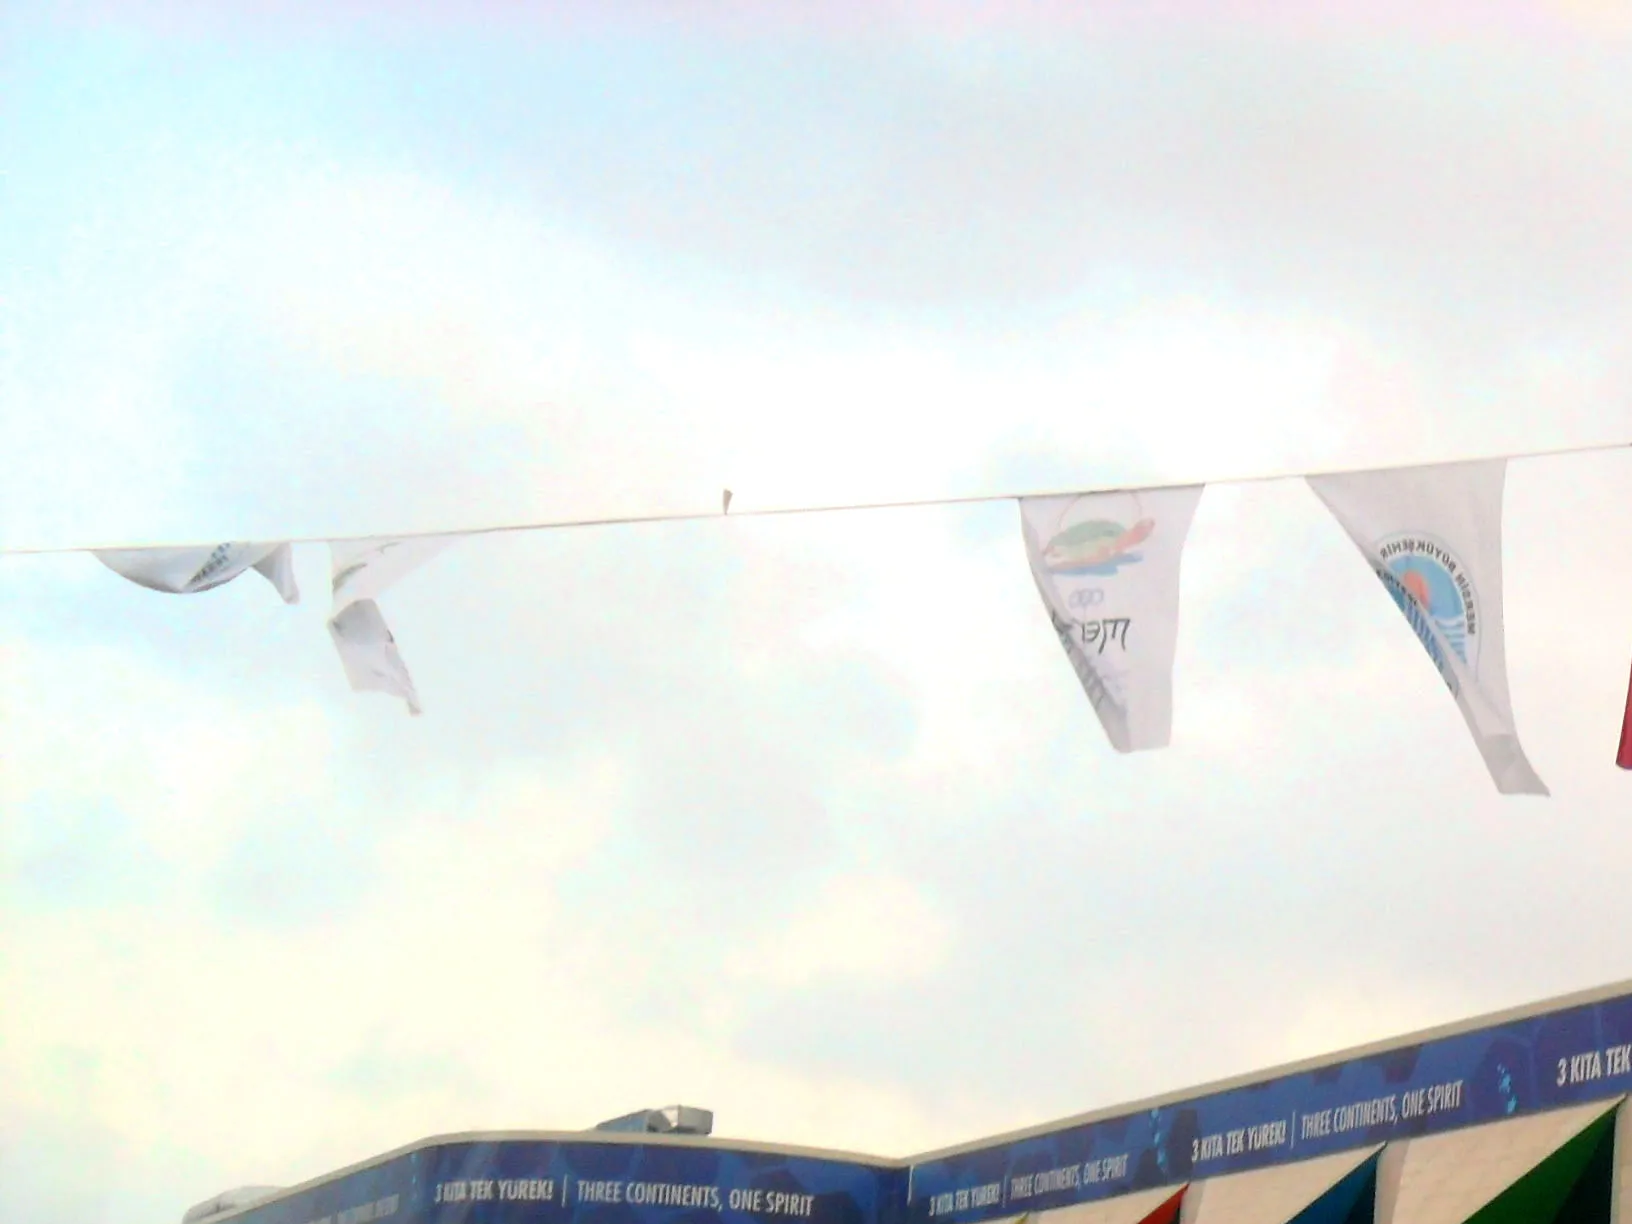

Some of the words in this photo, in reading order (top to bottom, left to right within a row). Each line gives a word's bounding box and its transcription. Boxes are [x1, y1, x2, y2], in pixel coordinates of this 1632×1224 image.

[1555, 1058, 1567, 1088] 3
[1570, 1050, 1602, 1082] KITA
[1605, 1044, 1631, 1075] TEK
[1191, 1138, 1199, 1163] 3
[1200, 1133, 1223, 1160] KITA
[1226, 1128, 1244, 1155] TEK
[1301, 1108, 1330, 1140] THREE
[1333, 1094, 1398, 1133] CONTINENTS,
[1401, 1088, 1425, 1119] ONE
[1427, 1079, 1464, 1114] SPIRIT
[470, 1179, 493, 1201] TEK
[577, 1179, 622, 1203] THREE
[626, 1182, 724, 1212] CONTINENTS,
[729, 1188, 761, 1212] ONE
[765, 1191, 816, 1217] SPIRIT
